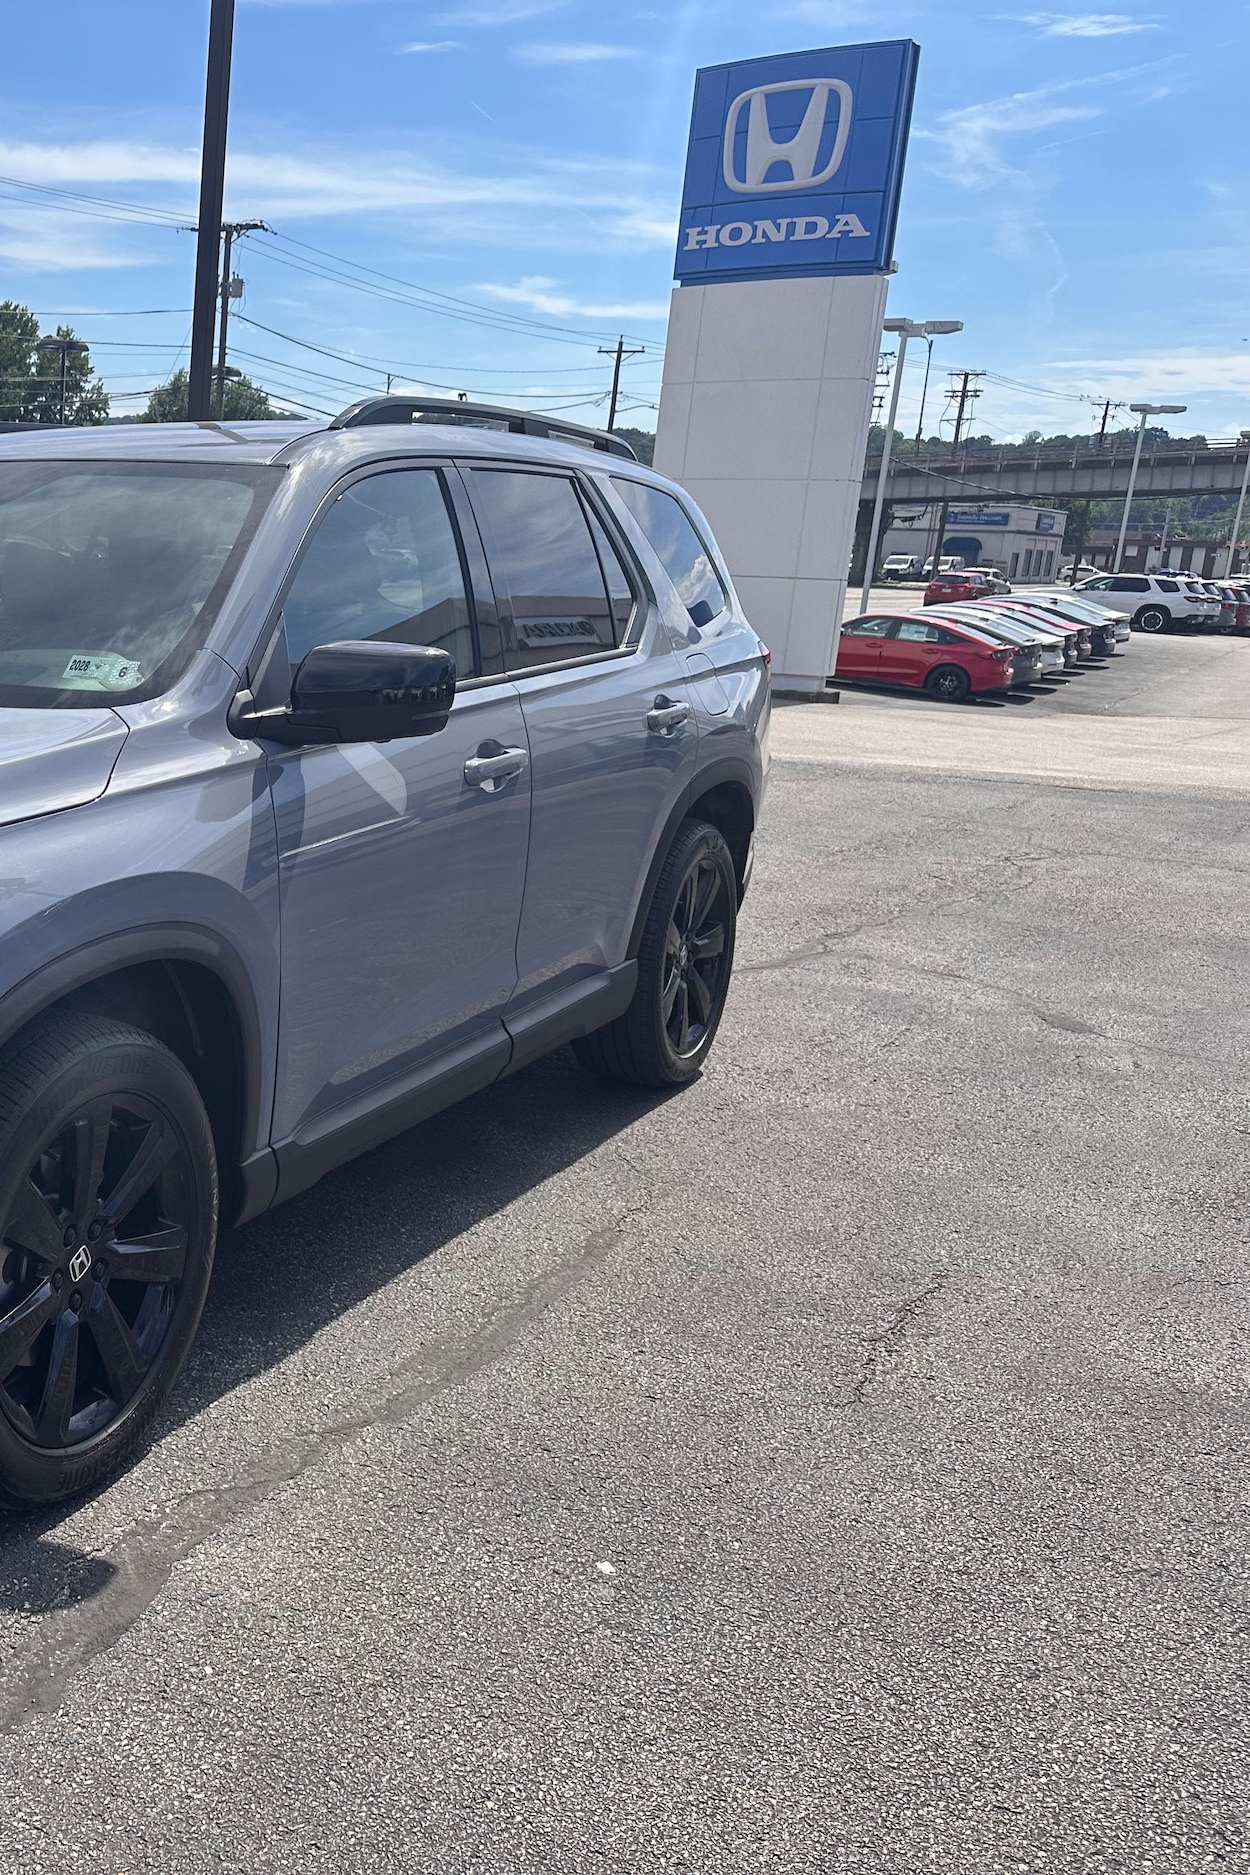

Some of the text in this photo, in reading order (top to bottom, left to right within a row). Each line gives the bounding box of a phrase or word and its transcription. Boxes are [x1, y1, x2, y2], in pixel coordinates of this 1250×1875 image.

[683, 213, 871, 252] HONDA
[69, 659, 91, 672] 2028
[118, 667, 128, 678] 6
